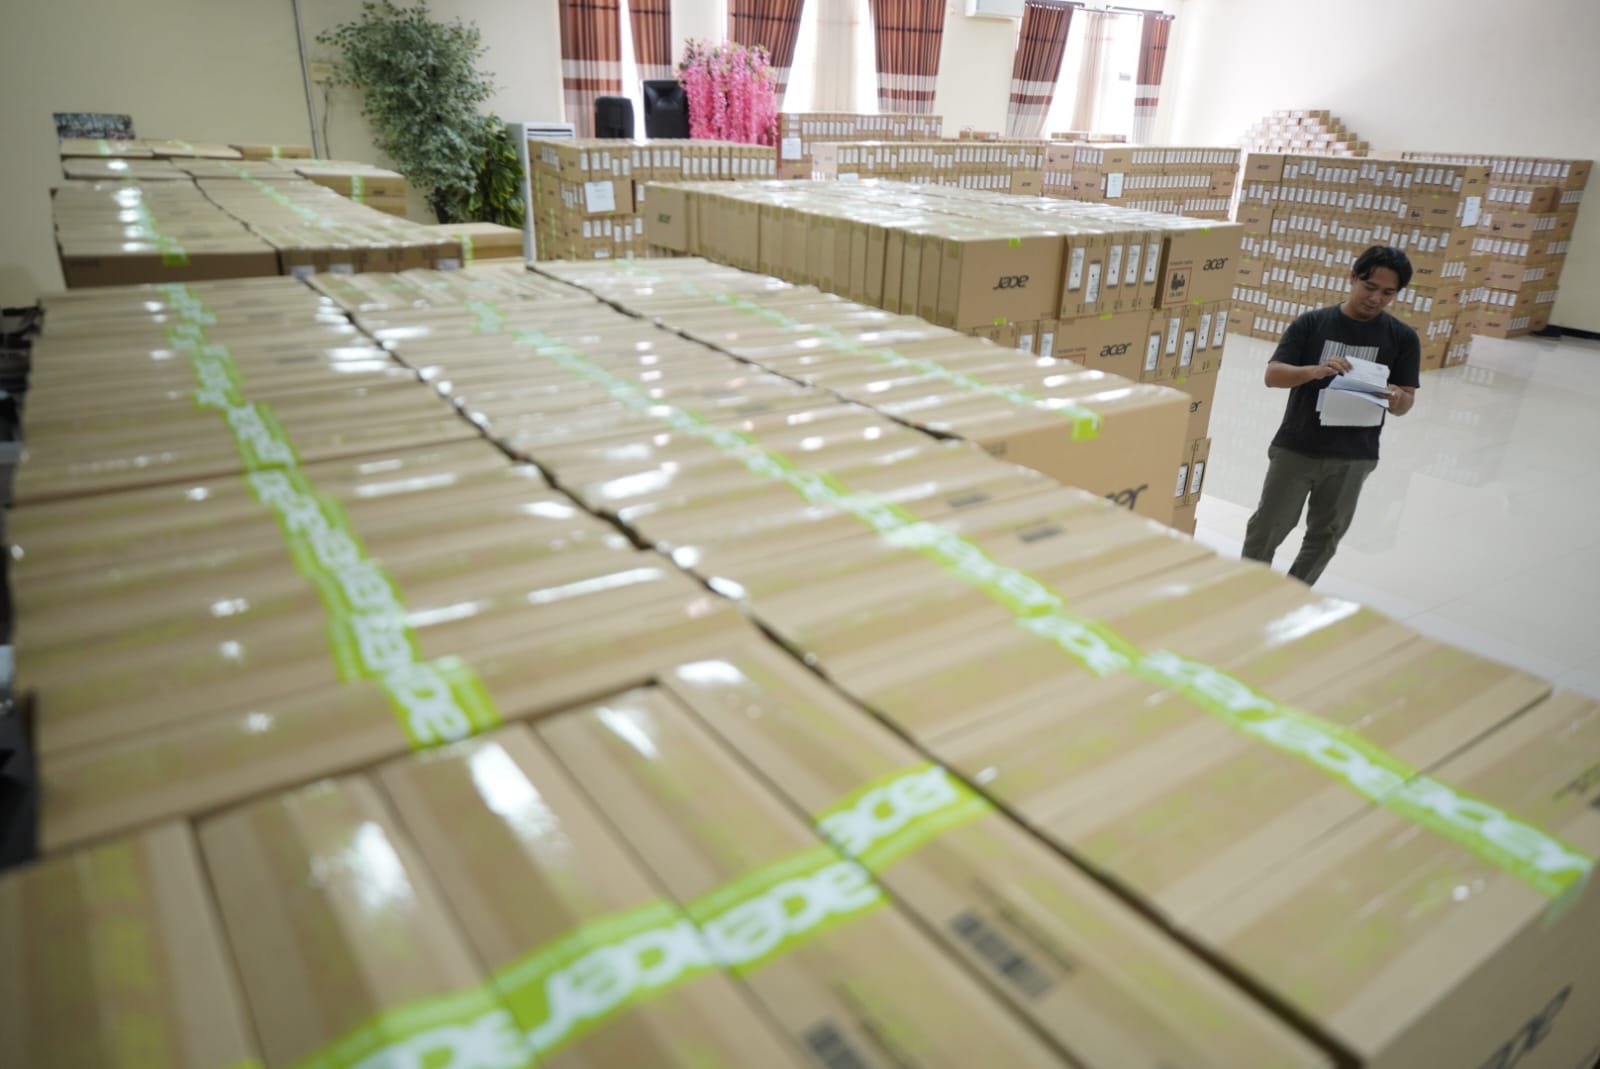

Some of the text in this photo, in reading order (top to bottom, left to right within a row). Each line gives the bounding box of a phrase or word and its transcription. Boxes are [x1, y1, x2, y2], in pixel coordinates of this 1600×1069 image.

[1203, 257, 1229, 271] acer
[992, 273, 1029, 291] acer
[1100, 342, 1132, 357] acer
[1189, 401, 1202, 413] er
